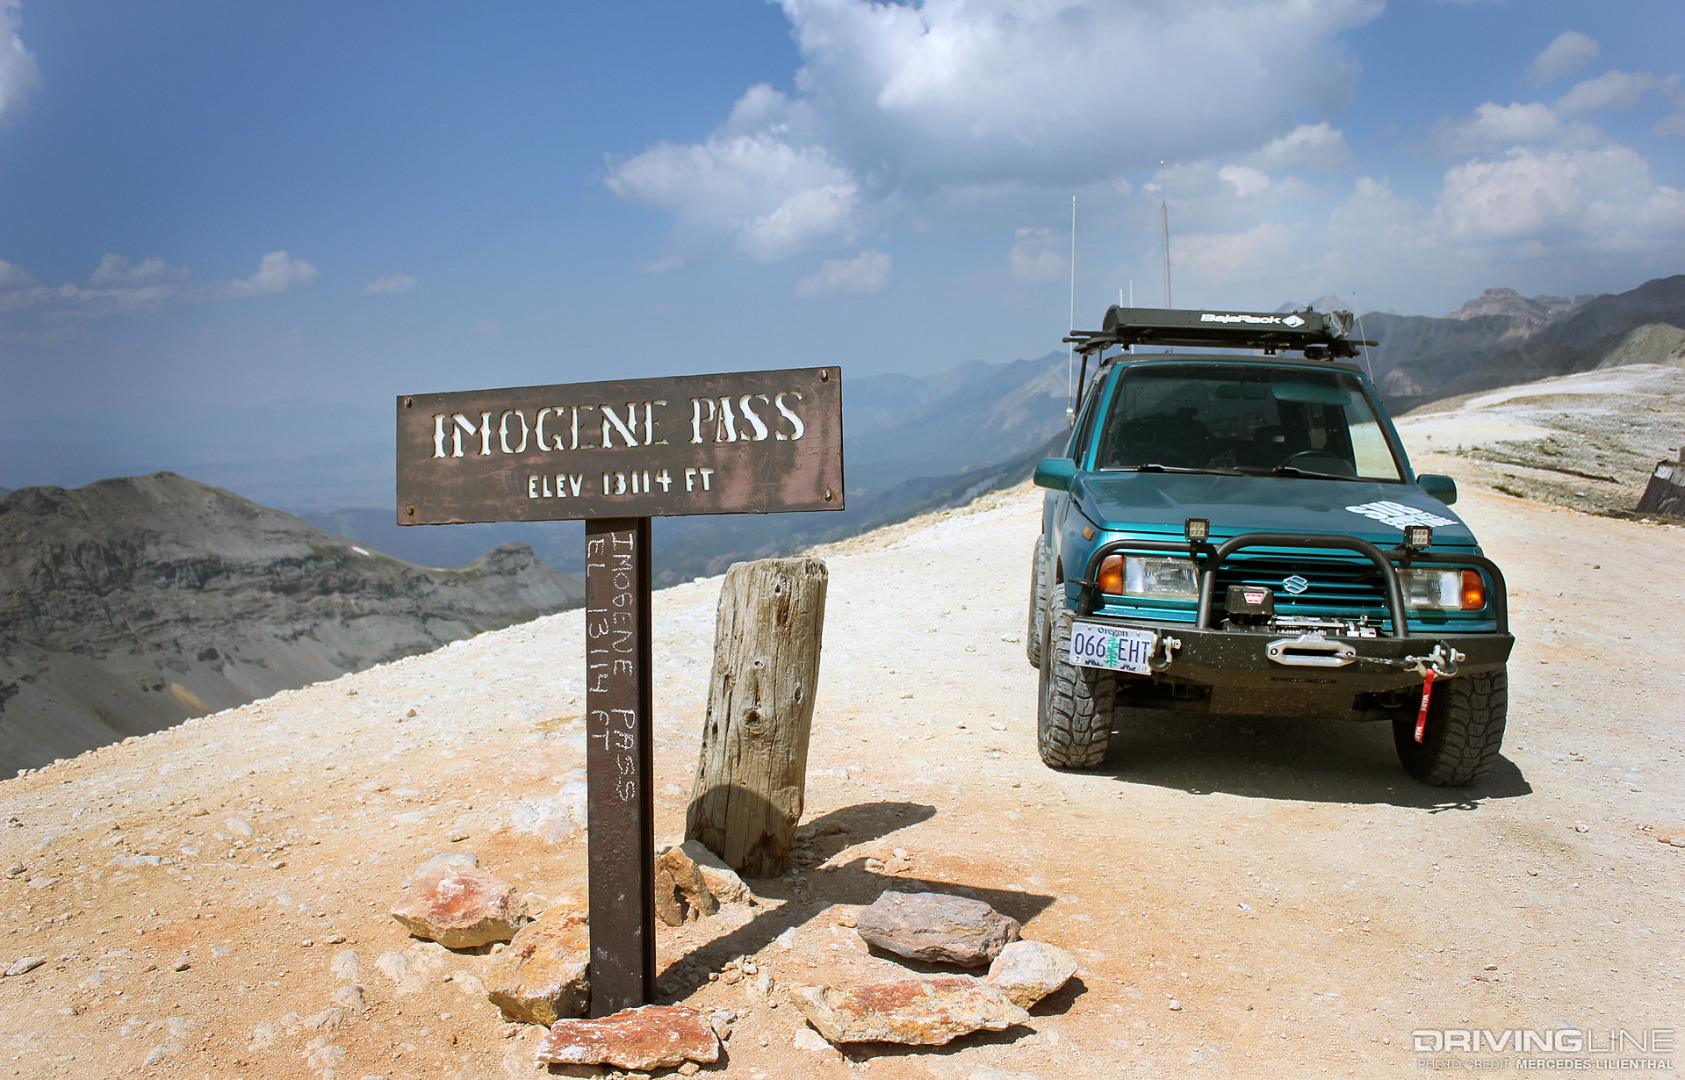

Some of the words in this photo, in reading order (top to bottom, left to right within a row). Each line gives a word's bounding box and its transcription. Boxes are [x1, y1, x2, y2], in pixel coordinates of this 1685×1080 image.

[1201, 313, 1281, 324] BajaRack
[431, 400, 669, 459] IMOGENE
[688, 391, 806, 444] PASS
[528, 473, 583, 499] ELEV
[602, 468, 672, 496] 13114
[684, 466, 715, 492] FT
[587, 538, 606, 578] EL
[611, 531, 634, 677] IMOGENE
[587, 608, 610, 693] 13114
[1074, 632, 1106, 657] 066
[1118, 638, 1150, 664] EHT
[1098, 626, 1128, 638] Oregon
[591, 709, 610, 751] FT
[610, 708, 636, 802] PASS
